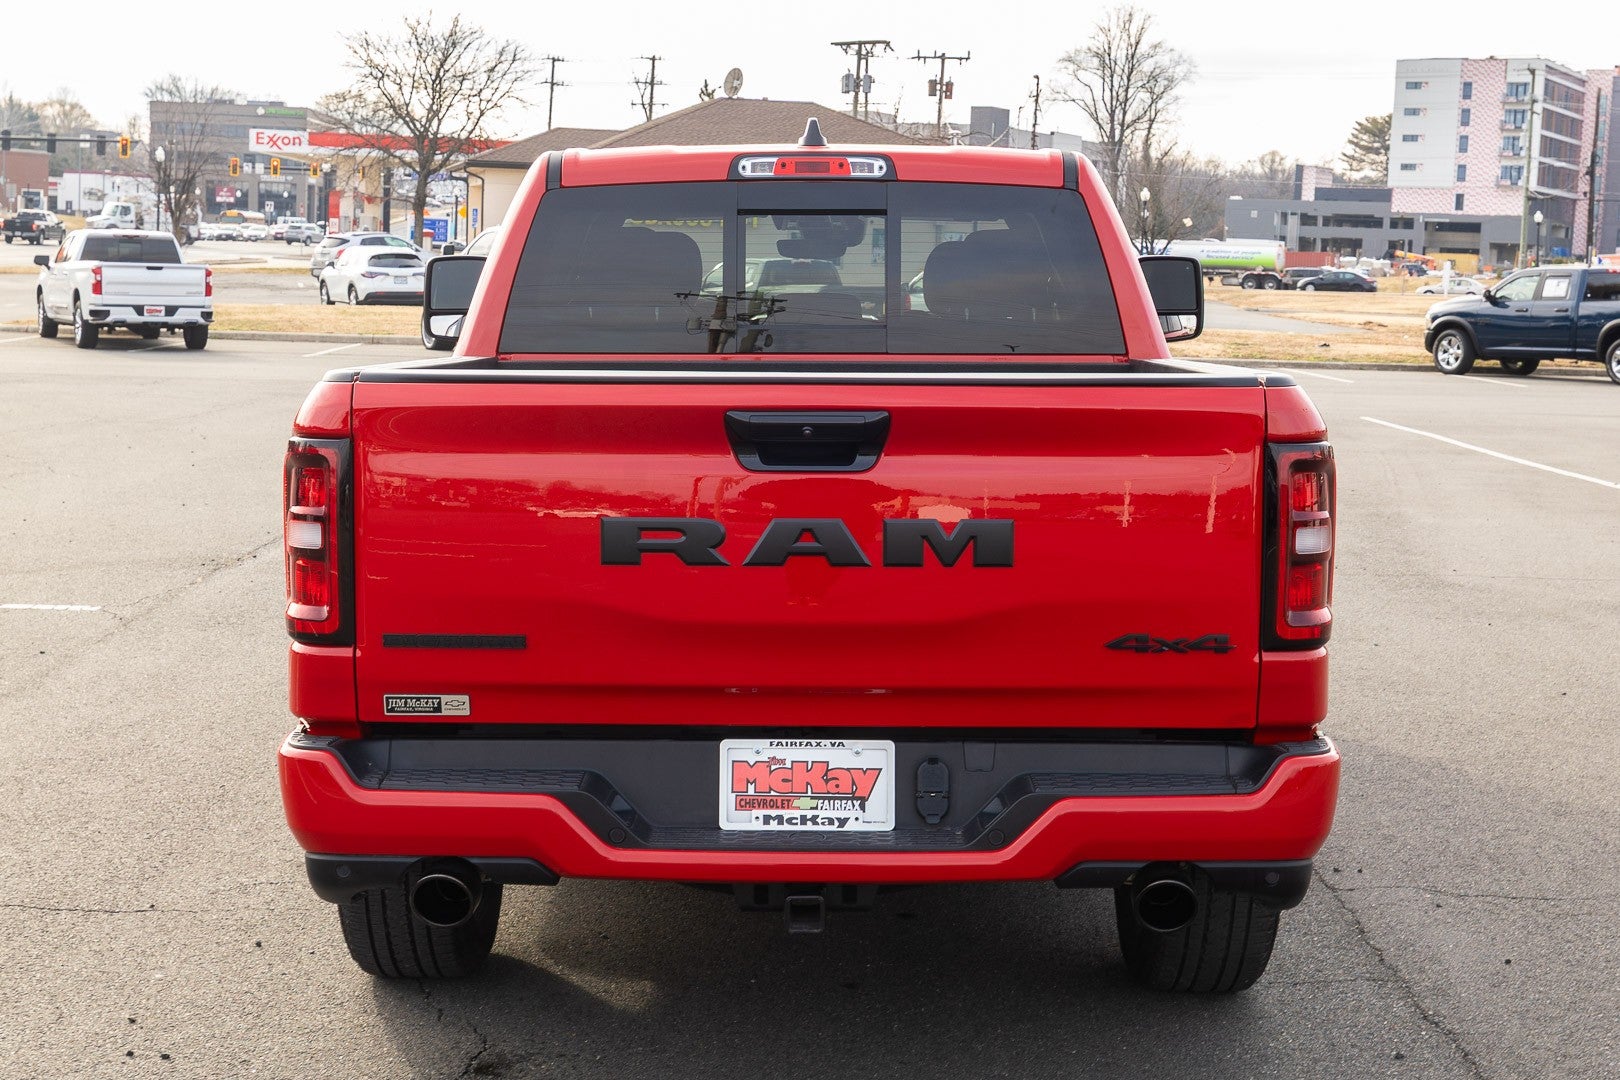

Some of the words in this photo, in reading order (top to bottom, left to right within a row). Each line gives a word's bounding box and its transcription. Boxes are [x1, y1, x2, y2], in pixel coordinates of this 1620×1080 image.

[256, 131, 302, 150] Exxon
[600, 517, 1015, 567] RAM
[1104, 633, 1238, 654] 4x4
[388, 699, 406, 709] JIM
[407, 699, 440, 707] McKAY
[731, 760, 883, 802] McKay
[738, 797, 792, 810] CHEVROLET
[817, 799, 862, 811] FAIRFAX
[762, 814, 851, 829] McKay
